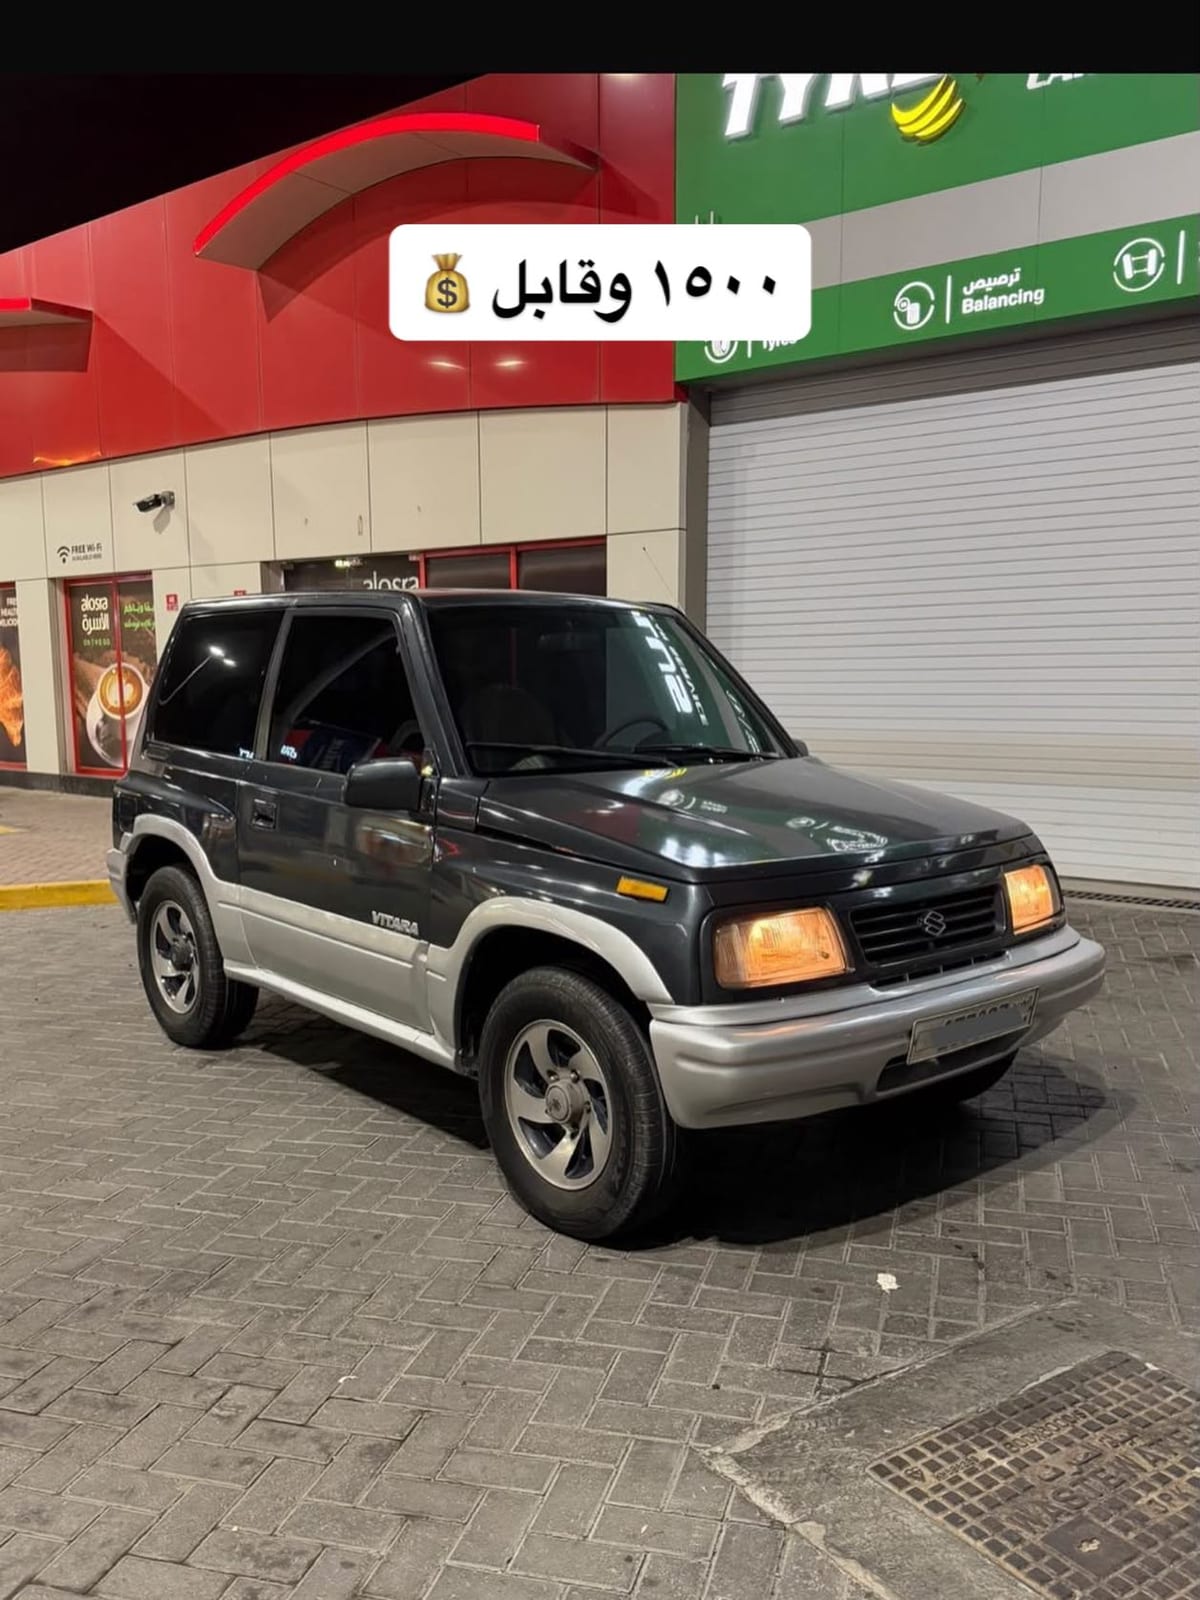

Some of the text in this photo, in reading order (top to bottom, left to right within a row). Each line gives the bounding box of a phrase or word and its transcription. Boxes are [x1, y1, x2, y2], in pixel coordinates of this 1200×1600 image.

[962, 267, 1021, 296] ترصيص
[962, 289, 1045, 315] Balancing
[81, 593, 108, 612] alosra
[371, 910, 419, 936] VITARA
